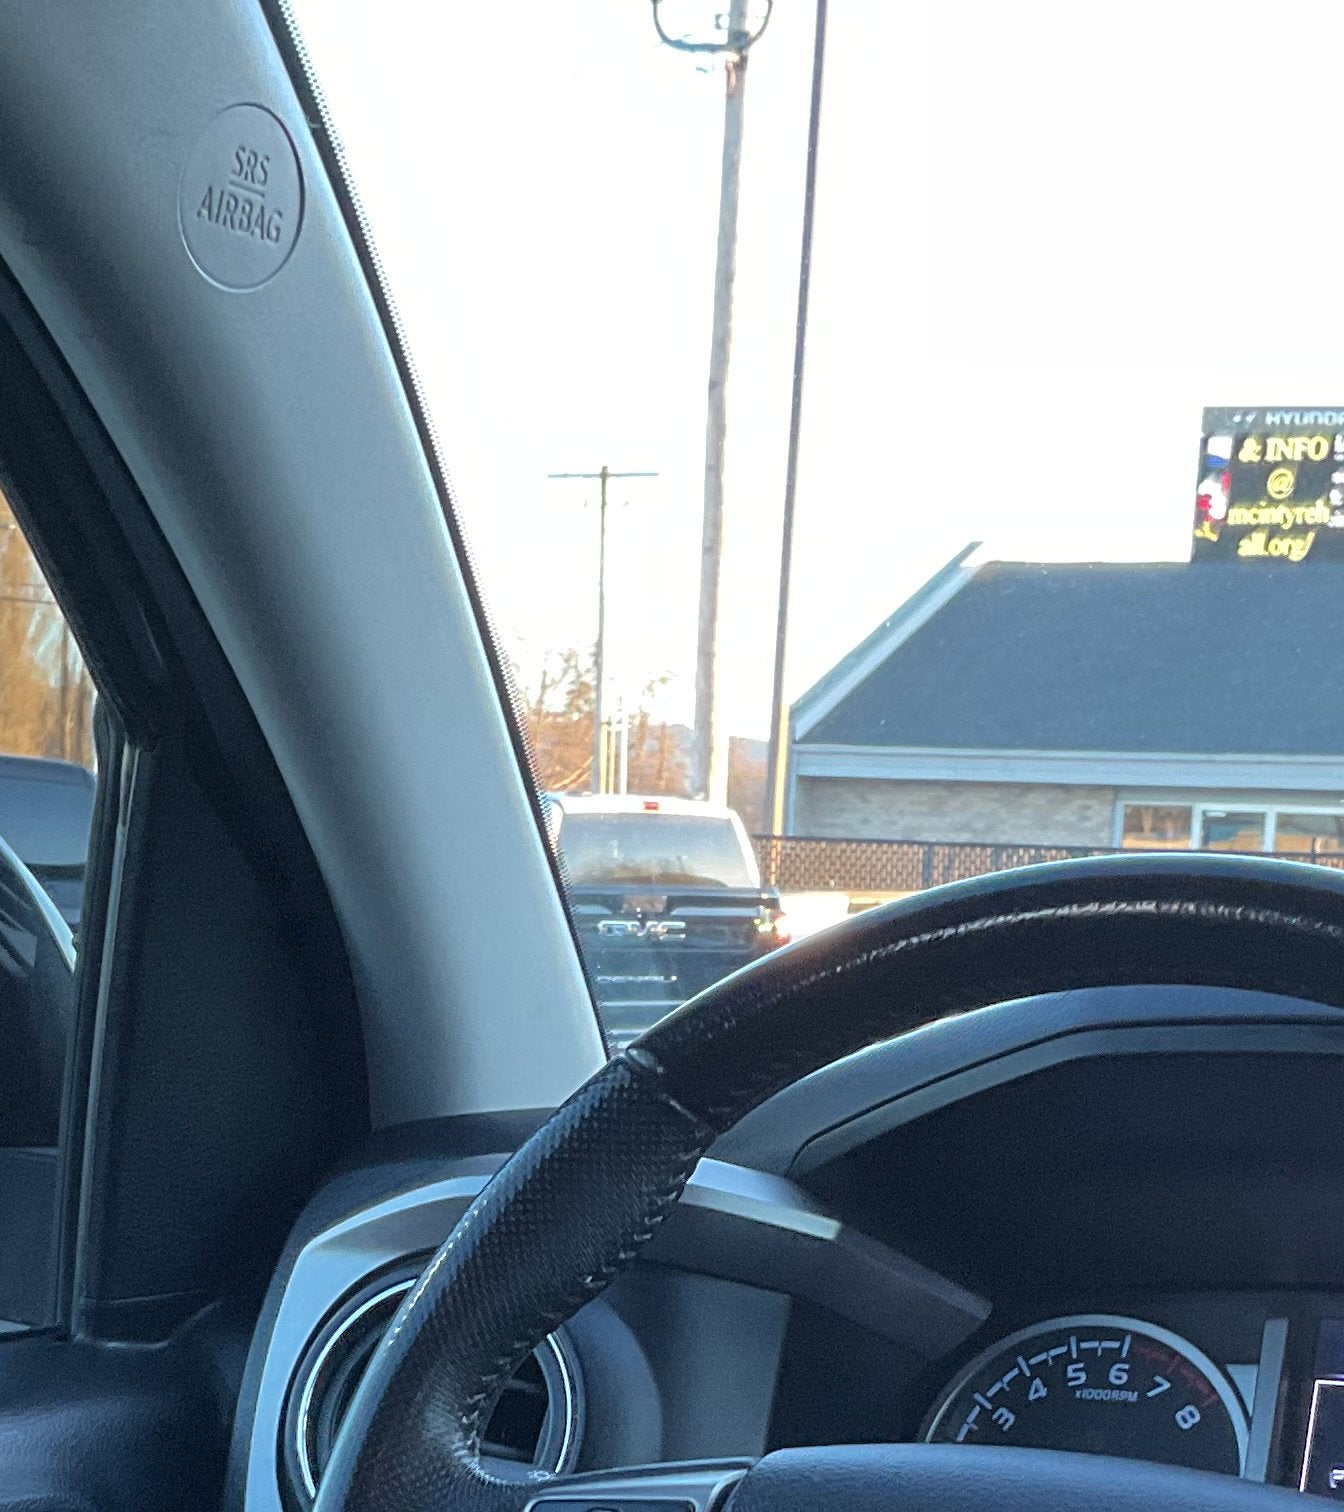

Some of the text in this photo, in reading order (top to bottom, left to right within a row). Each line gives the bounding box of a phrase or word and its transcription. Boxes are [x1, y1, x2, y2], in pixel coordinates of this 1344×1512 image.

[231, 144, 270, 187] SRS
[196, 186, 283, 243] AIRBAG
[1237, 437, 1262, 463] &
[1264, 435, 1329, 462] INFO
[1266, 467, 1295, 499] @
[992, 1362, 1201, 1432] 3 4 5 6 7 8
